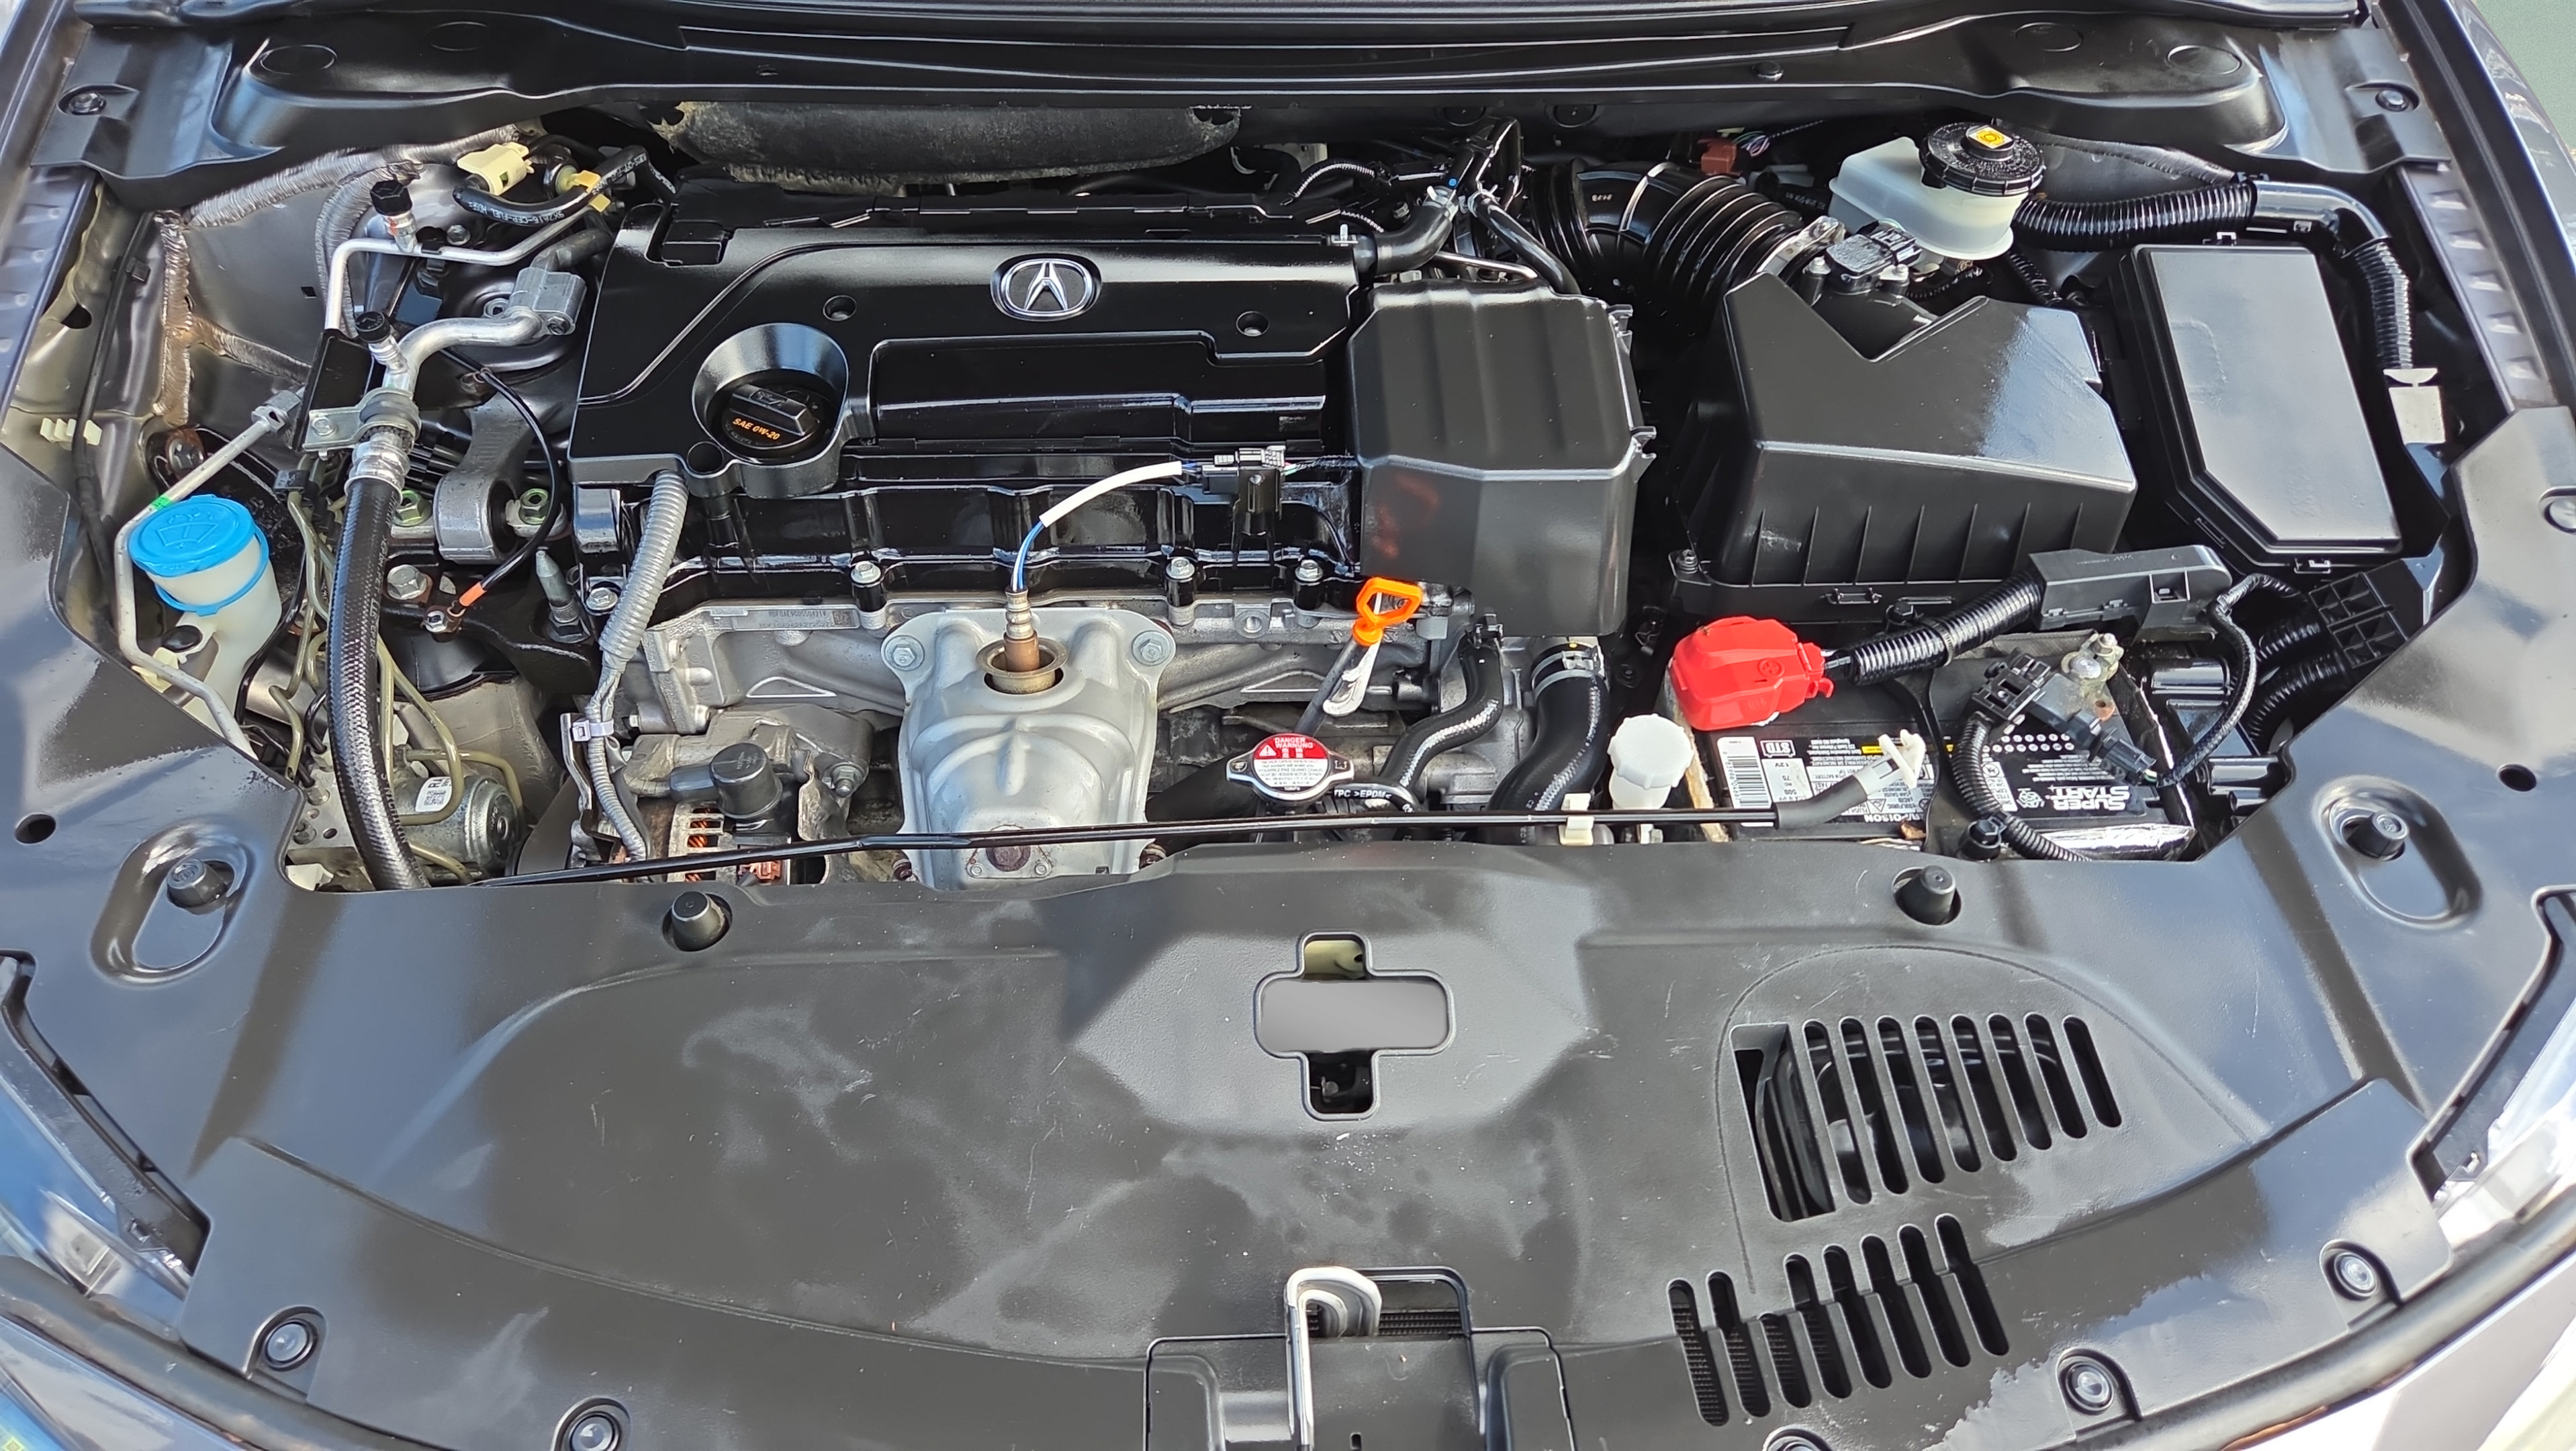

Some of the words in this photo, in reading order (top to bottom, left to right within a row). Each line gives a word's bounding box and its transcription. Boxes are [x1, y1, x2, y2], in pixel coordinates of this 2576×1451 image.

[732, 418, 753, 430] SAE
[752, 425, 780, 440] 0W-20
[1766, 742, 1792, 754] STD
[2050, 785, 2130, 800] START
[2053, 799, 2127, 811] SUPER
